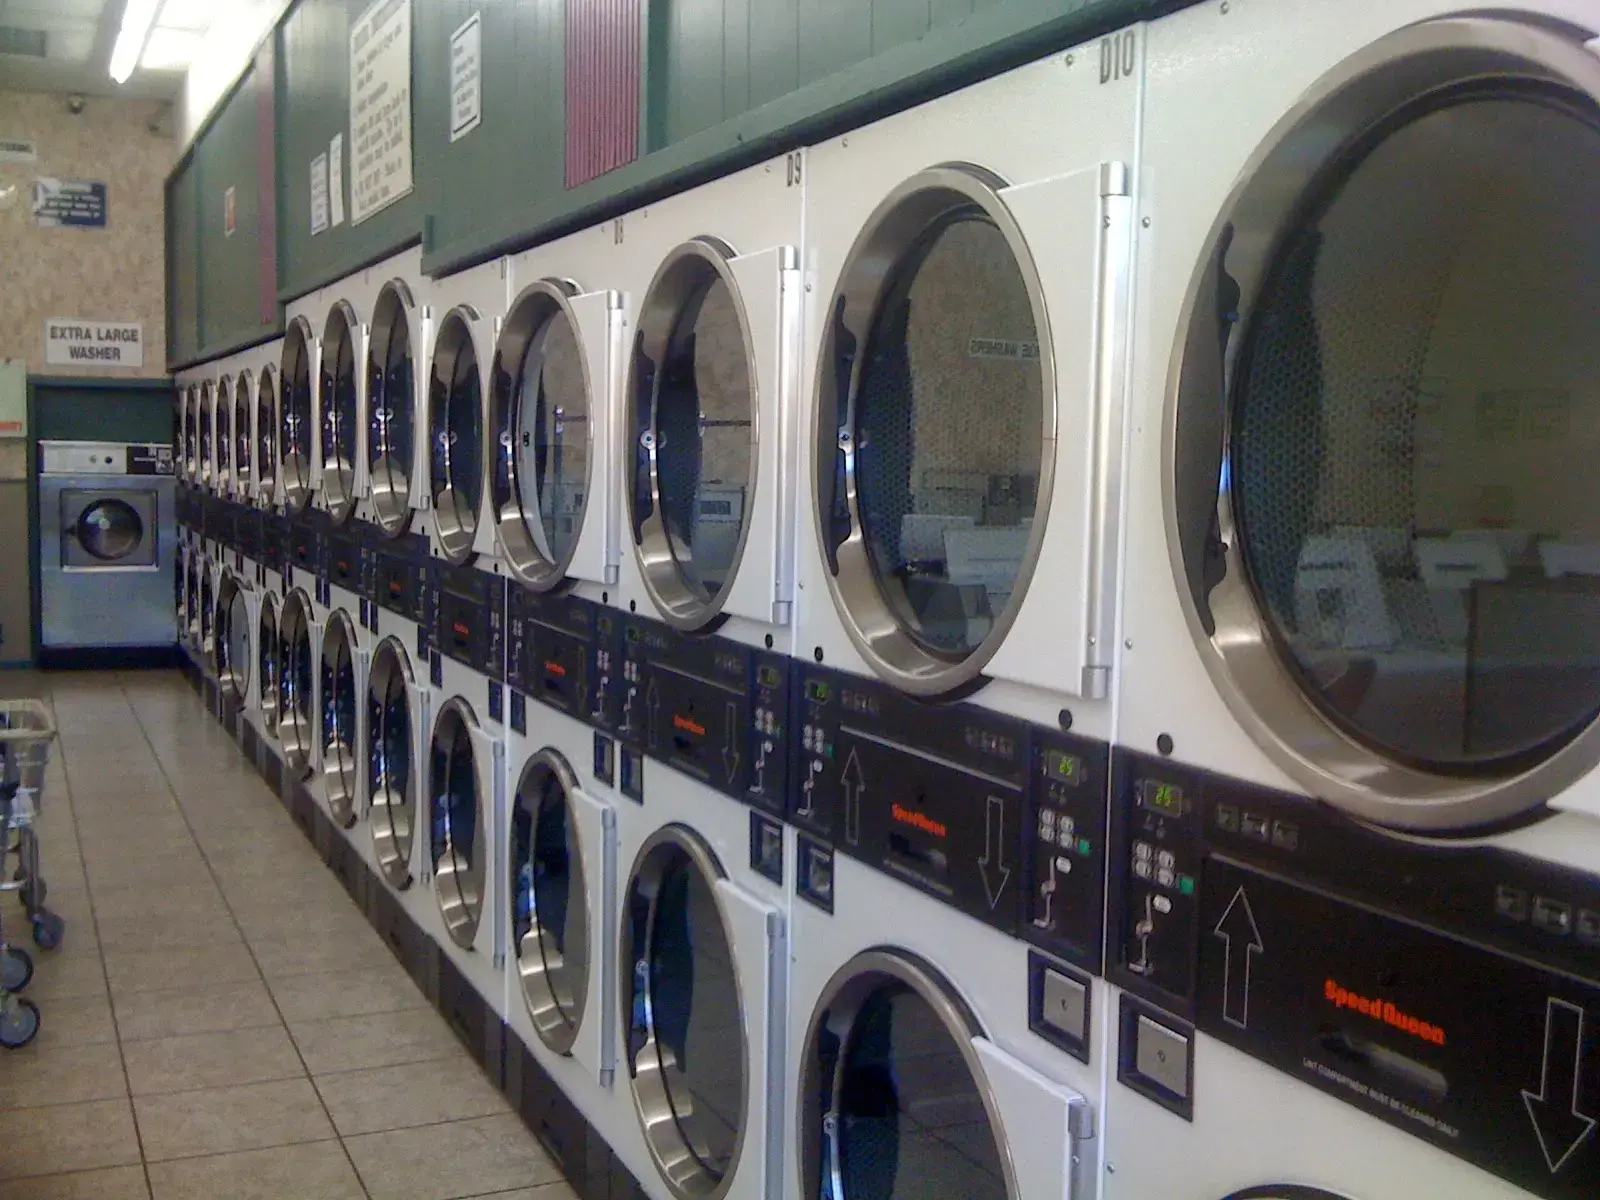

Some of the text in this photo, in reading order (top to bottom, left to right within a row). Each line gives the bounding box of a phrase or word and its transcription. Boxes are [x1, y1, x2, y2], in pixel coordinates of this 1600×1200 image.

[1100, 29, 1134, 84] D10
[787, 152, 801, 180] D9
[50, 325, 139, 343] EXTRA LARGE
[68, 345, 121, 361] WASHER
[1325, 979, 1444, 1045] Speed Queen
